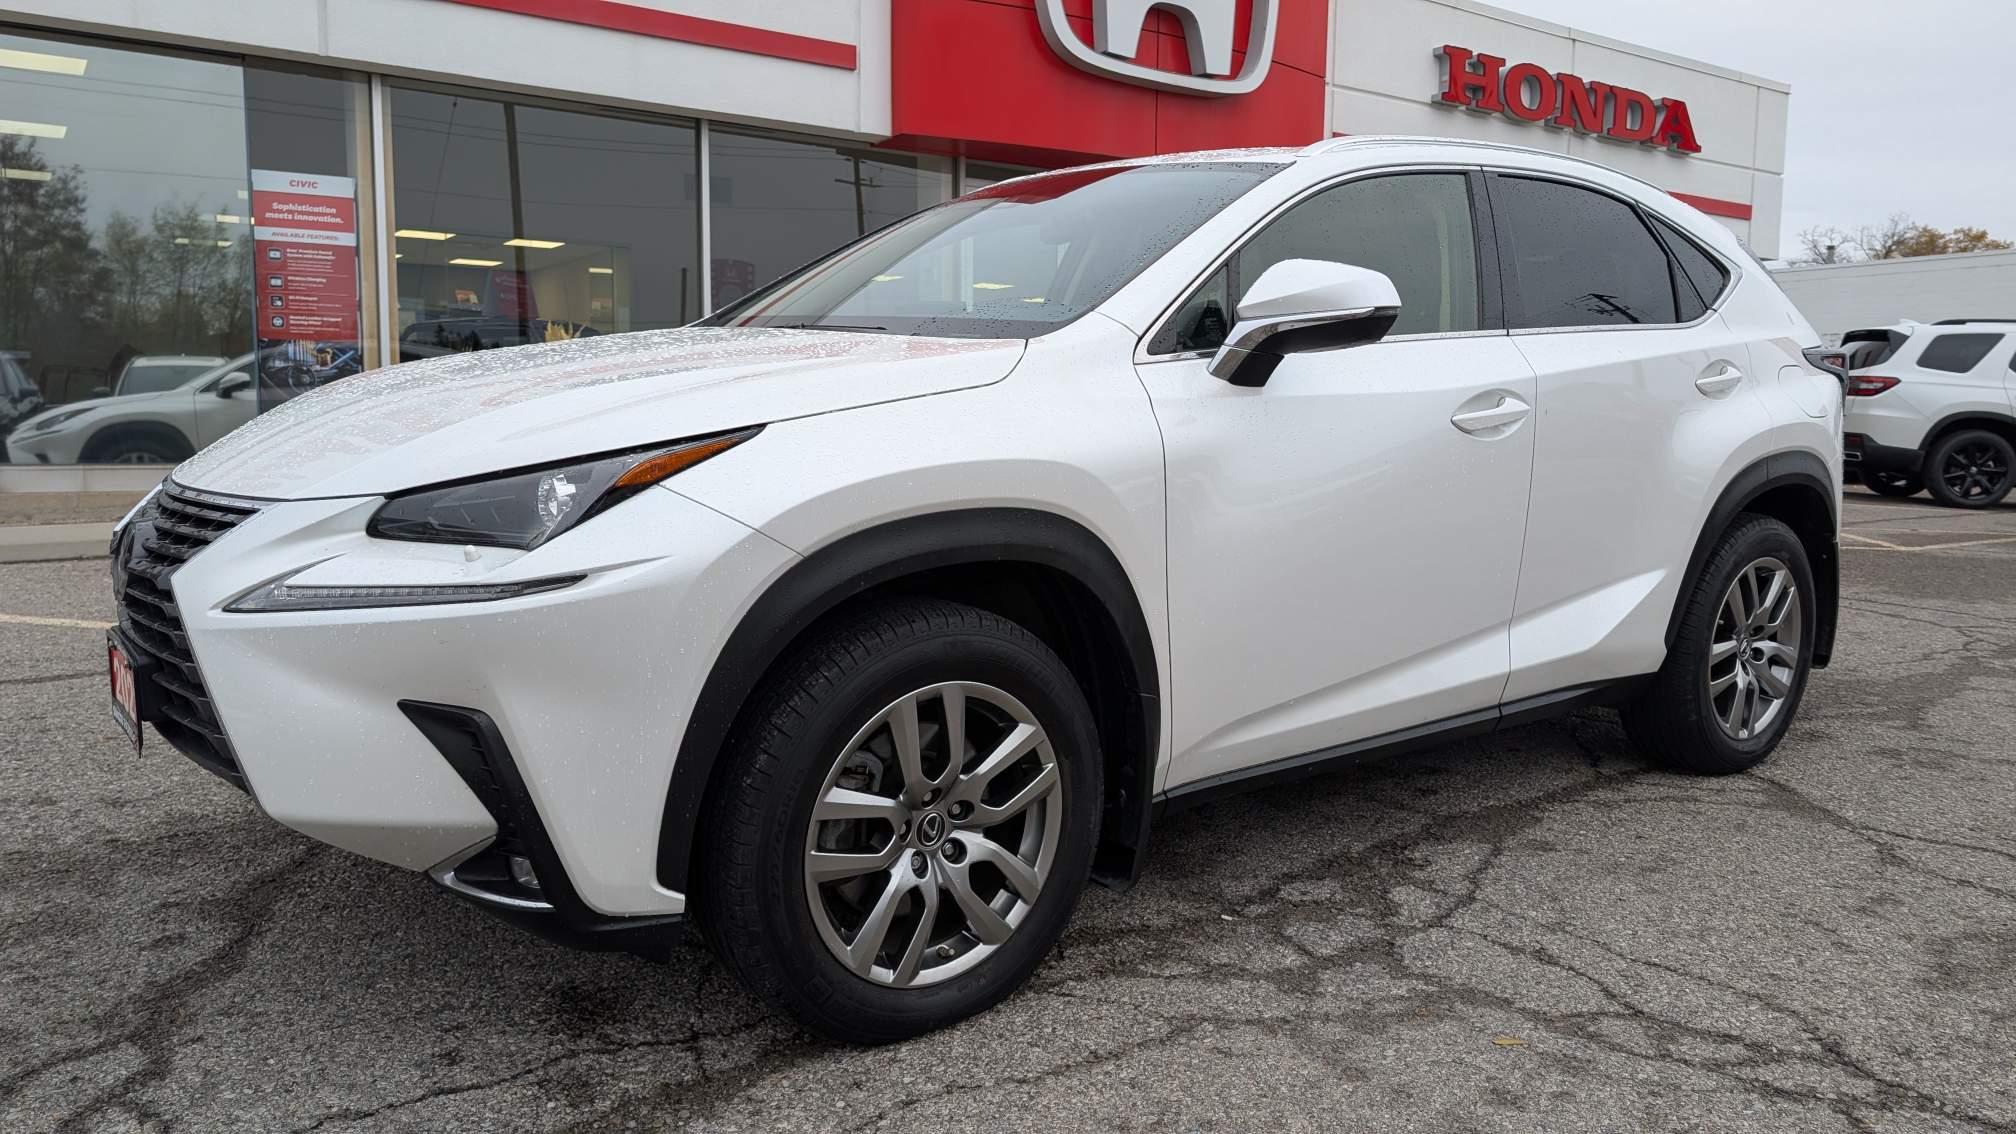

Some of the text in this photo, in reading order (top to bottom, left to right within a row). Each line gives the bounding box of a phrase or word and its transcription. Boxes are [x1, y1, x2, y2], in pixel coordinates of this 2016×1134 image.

[1436, 45, 1702, 153] HONDA
[289, 179, 319, 189] CIVIC
[272, 202, 337, 214] Sophistication
[265, 212, 344, 224] meets innovation.
